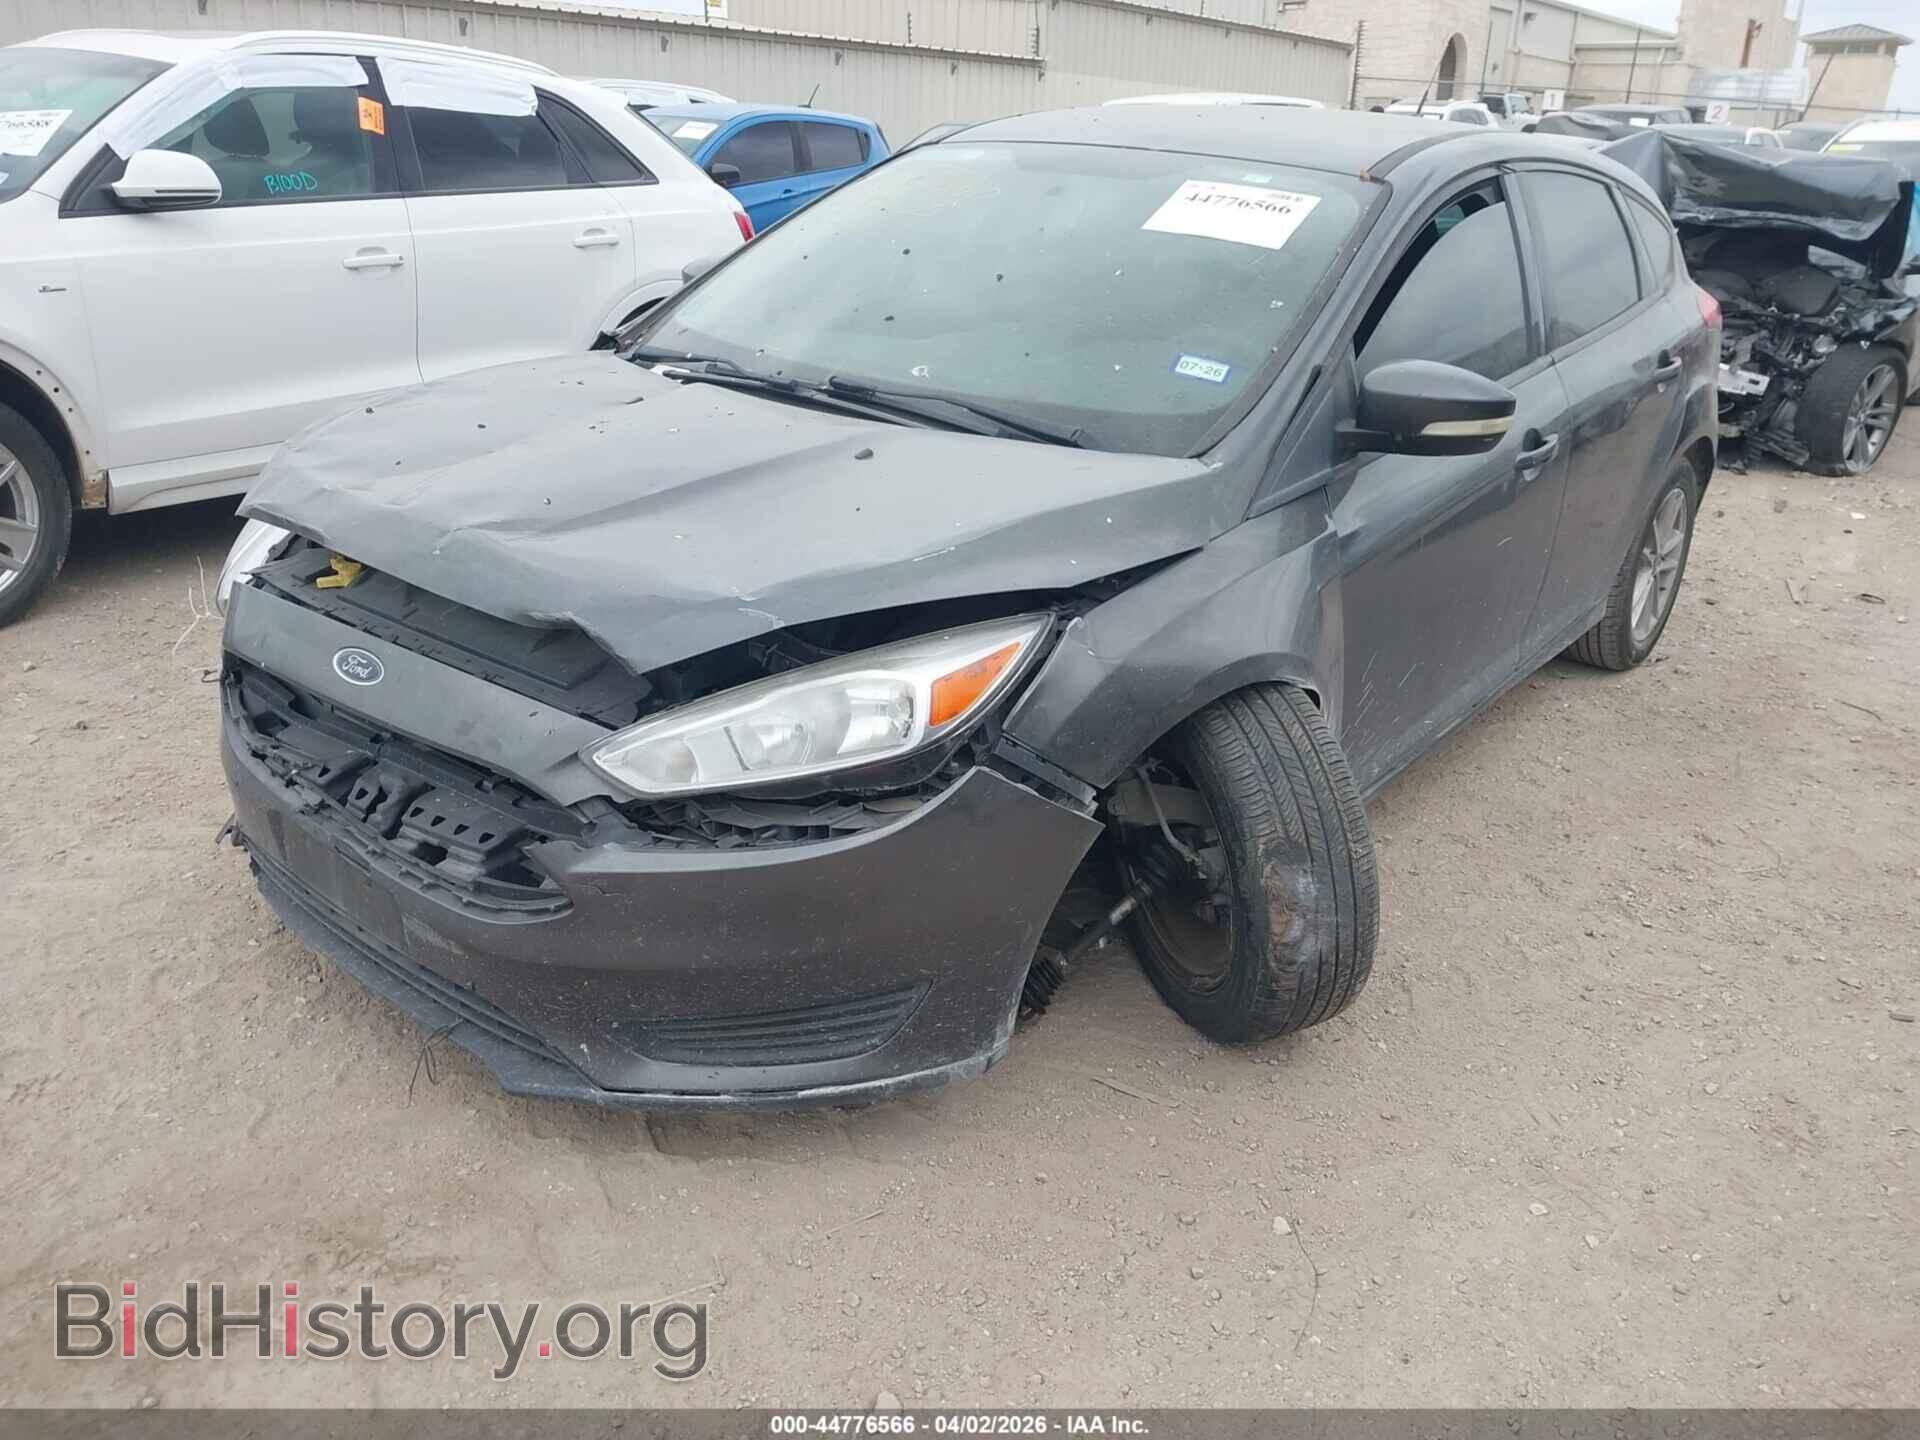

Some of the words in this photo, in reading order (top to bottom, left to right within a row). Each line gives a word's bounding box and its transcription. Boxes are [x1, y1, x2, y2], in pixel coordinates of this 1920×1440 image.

[1711, 104, 1723, 120] 2
[1184, 191, 1292, 216] 44776566
[342, 654, 373, 679] Ford
